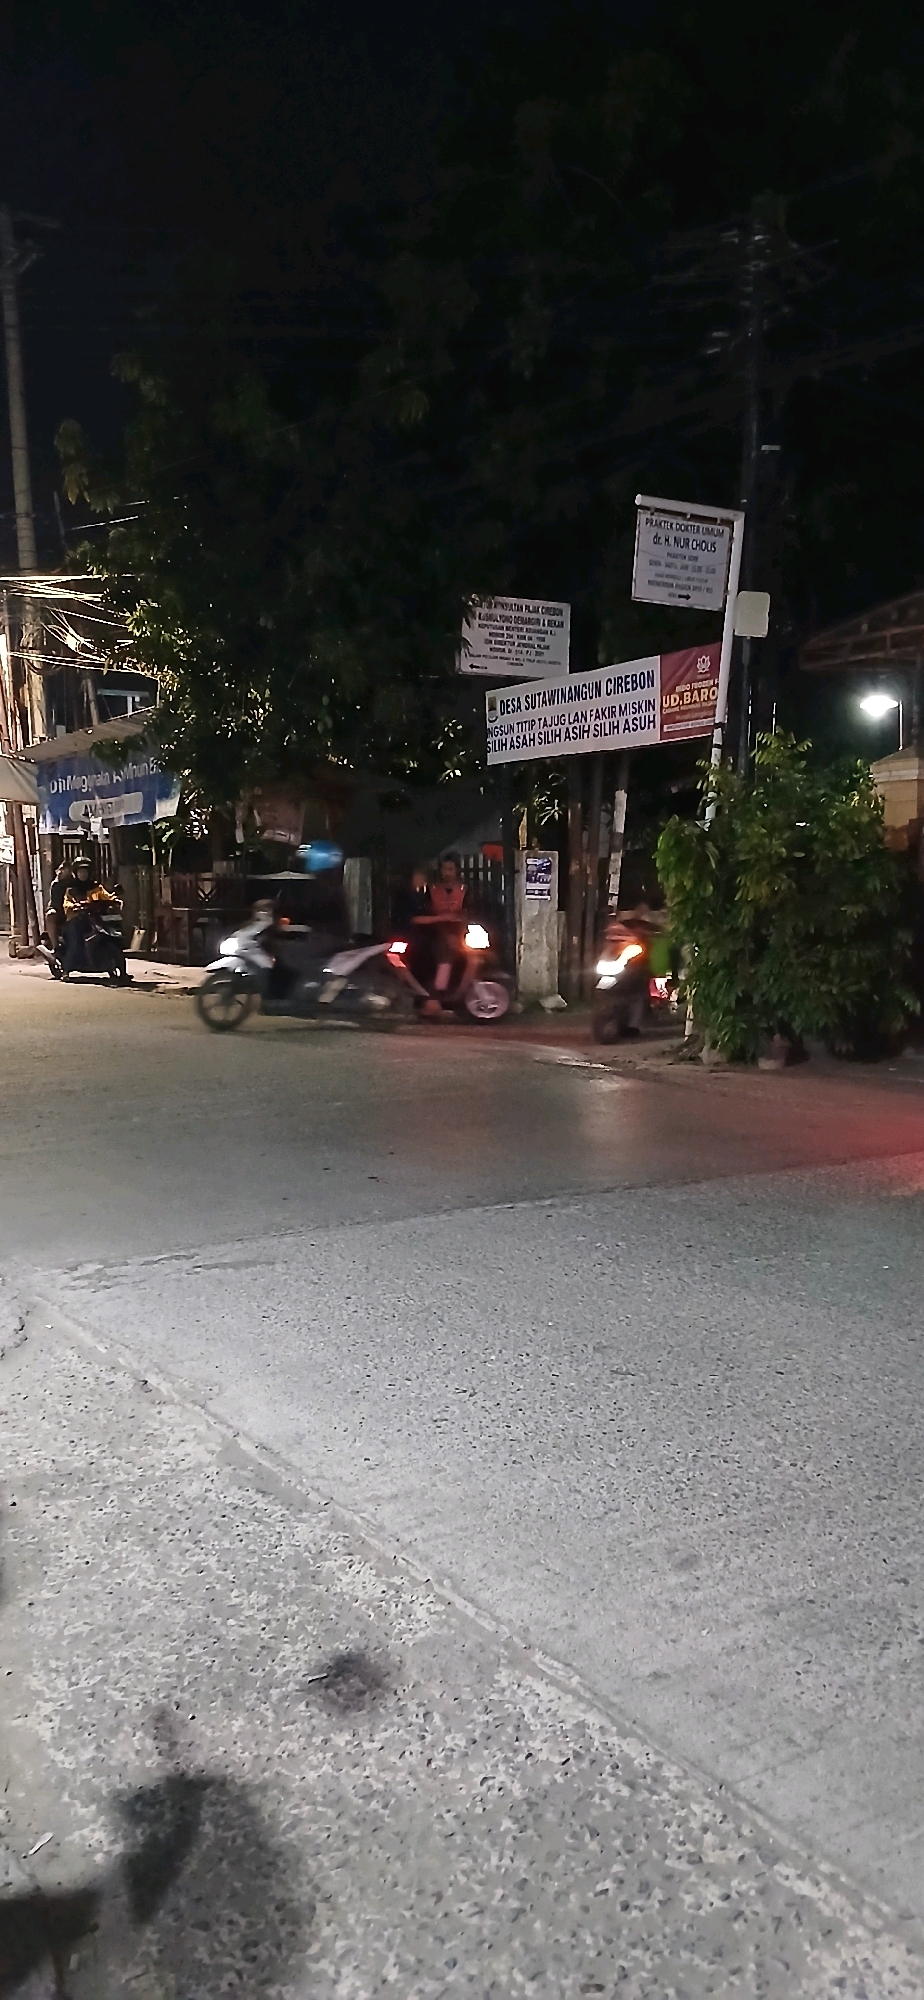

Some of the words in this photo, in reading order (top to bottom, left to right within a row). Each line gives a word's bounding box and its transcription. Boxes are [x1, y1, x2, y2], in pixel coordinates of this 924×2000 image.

[645, 518, 673, 530] PRAKTEK
[676, 523, 700, 534] DOKTER
[702, 526, 724, 537] UMUM
[653, 532, 662, 545] dr.
[665, 536, 671, 546] H.
[674, 536, 689, 549] NUR
[692, 539, 716, 552] CHOLIS
[525, 605, 540, 613] PAJAK
[541, 606, 563, 616] CIREBON
[500, 698, 522, 716] DESA
[525, 680, 601, 712] SUTAWINANGUN
[606, 670, 654, 696] CIREBON
[517, 719, 536, 733] TITIP
[538, 713, 566, 730] TAJUG
[568, 711, 587, 726] LAN
[589, 706, 617, 722] FAKIR
[619, 699, 656, 717] MISKIN
[486, 736, 507, 753] SILIH
[509, 731, 536, 749] ASAH
[538, 727, 561, 744] SILIH
[564, 723, 590, 742] ASIH
[593, 720, 619, 738] SILIH
[623, 714, 657, 732] ASUH
